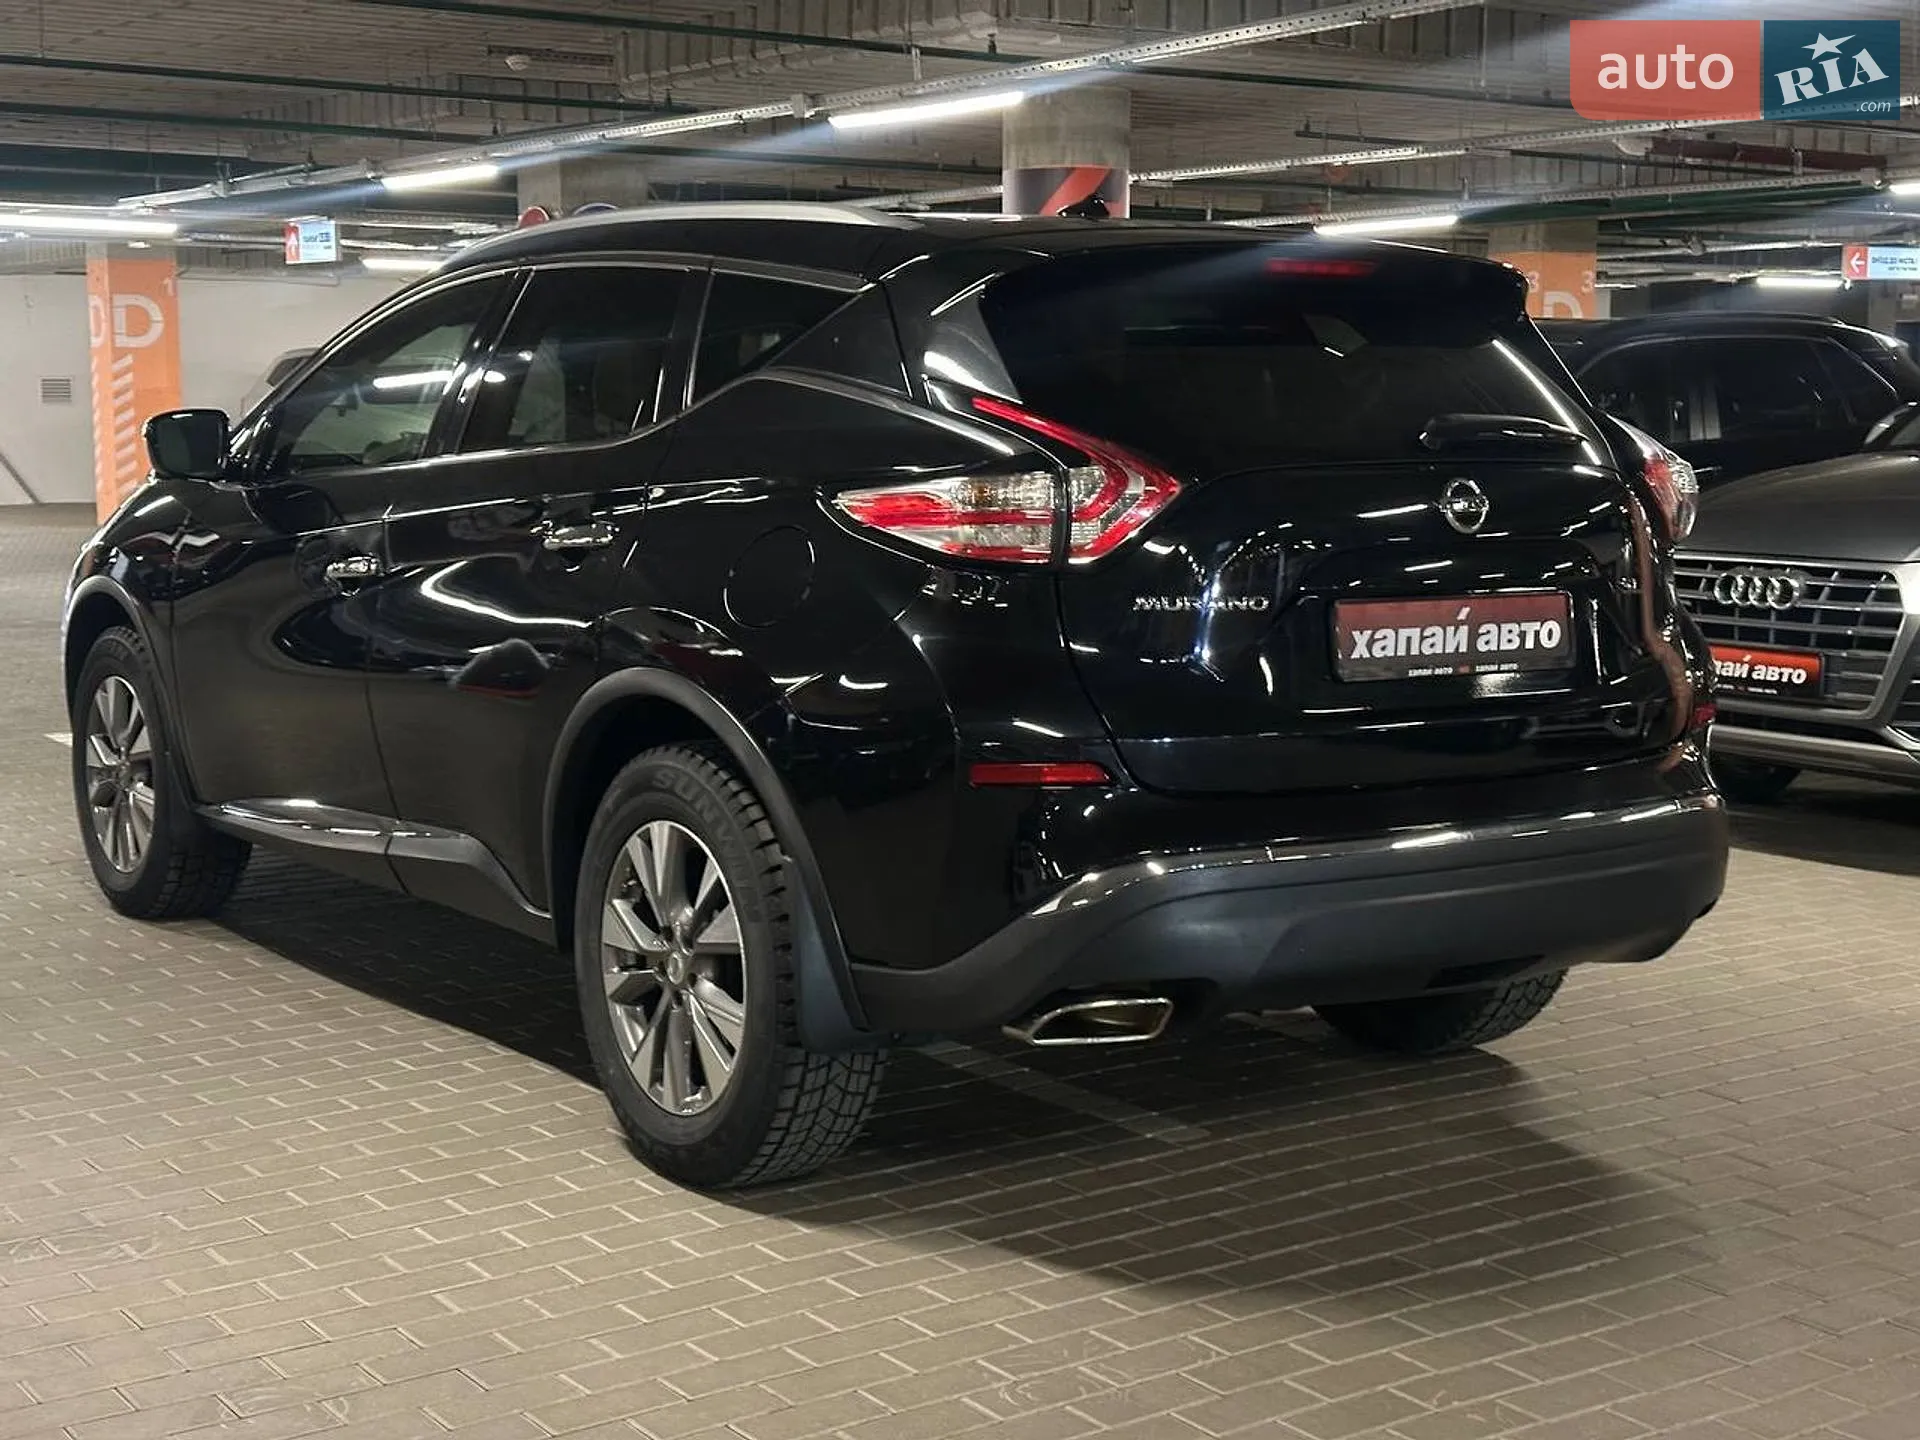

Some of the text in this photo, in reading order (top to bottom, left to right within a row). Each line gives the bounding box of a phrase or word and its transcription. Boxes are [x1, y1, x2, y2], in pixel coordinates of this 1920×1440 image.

[1581, 271, 1593, 293] 3
[112, 294, 165, 348] D
[1132, 596, 1270, 612] MURANO
[1476, 619, 1562, 652] авто
[1752, 663, 1807, 684] авто
